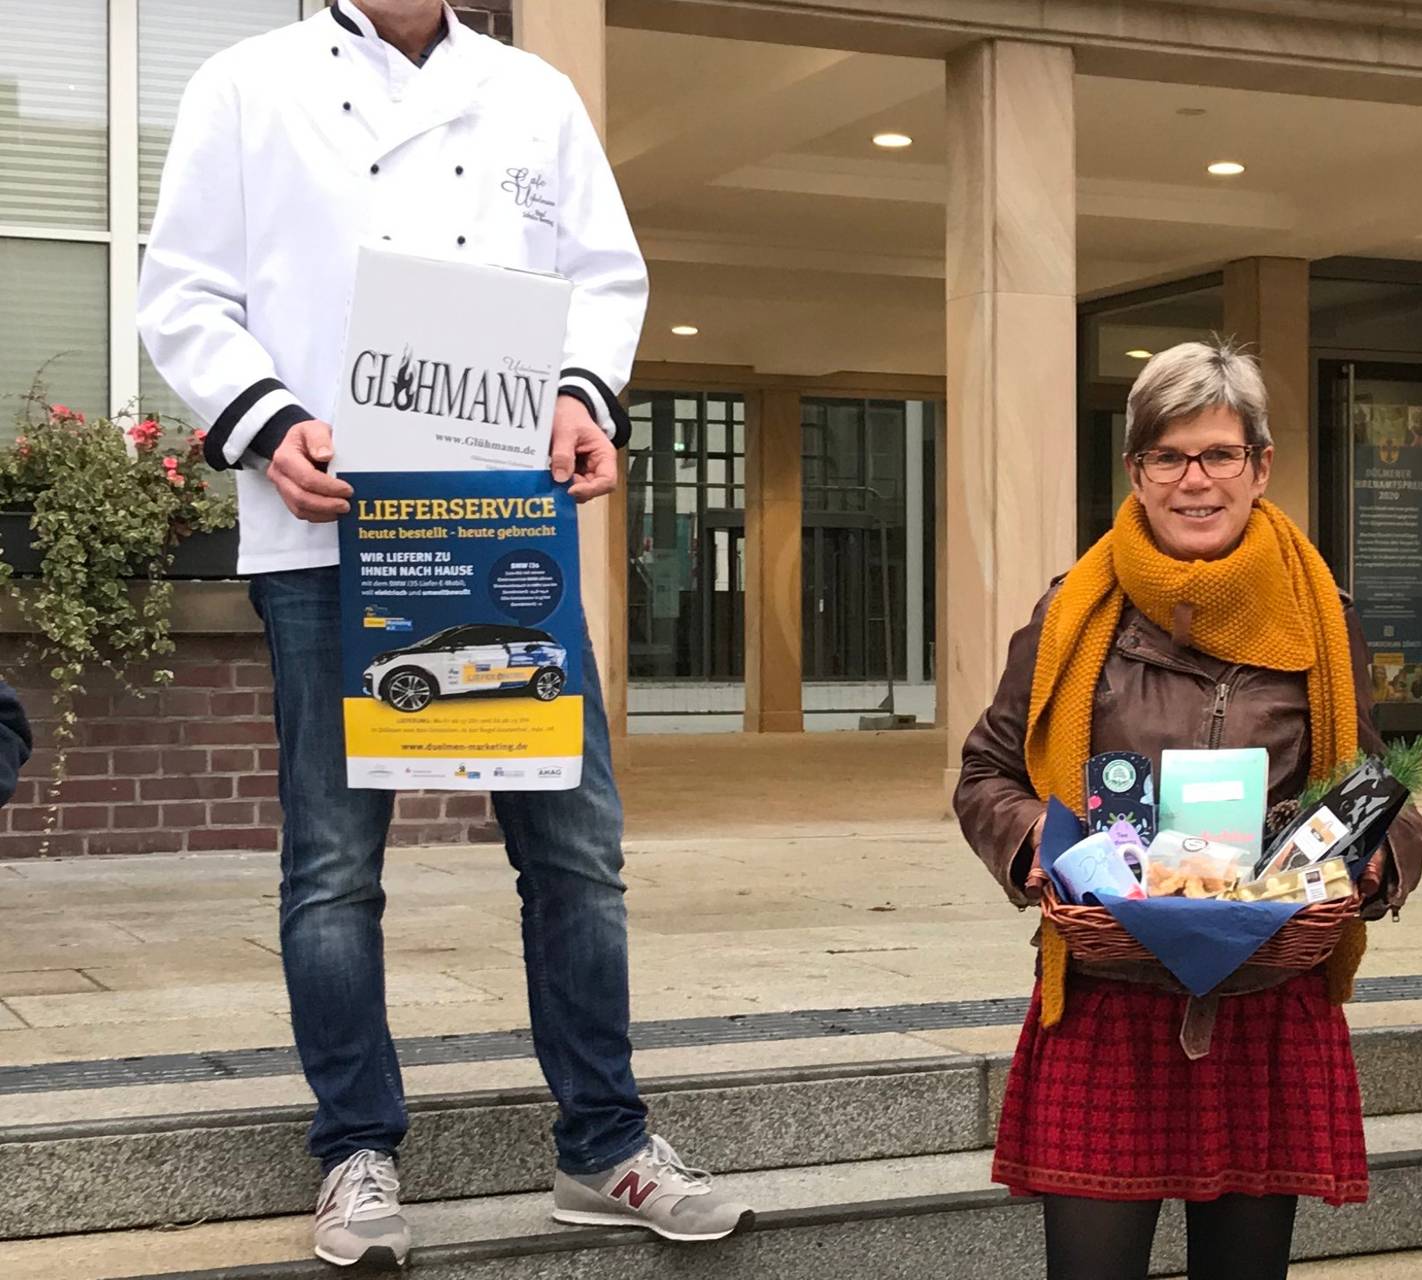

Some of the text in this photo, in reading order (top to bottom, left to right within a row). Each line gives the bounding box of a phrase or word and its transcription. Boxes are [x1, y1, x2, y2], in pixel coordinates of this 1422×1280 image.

[435, 433, 536, 455] www.Glühmann.de
[358, 497, 556, 521] LIEFERSERVICE
[358, 527, 396, 539] heute
[399, 527, 448, 539] bestellt
[457, 526, 495, 538] heute
[497, 525, 557, 540] gebracht
[360, 552, 451, 562] WIR LIEFERN ZU
[361, 565, 474, 576] IHNEN NACH HAUSE
[401, 742, 528, 752] www.duelmen-marketing.de
[609, 1168, 660, 1211] N
